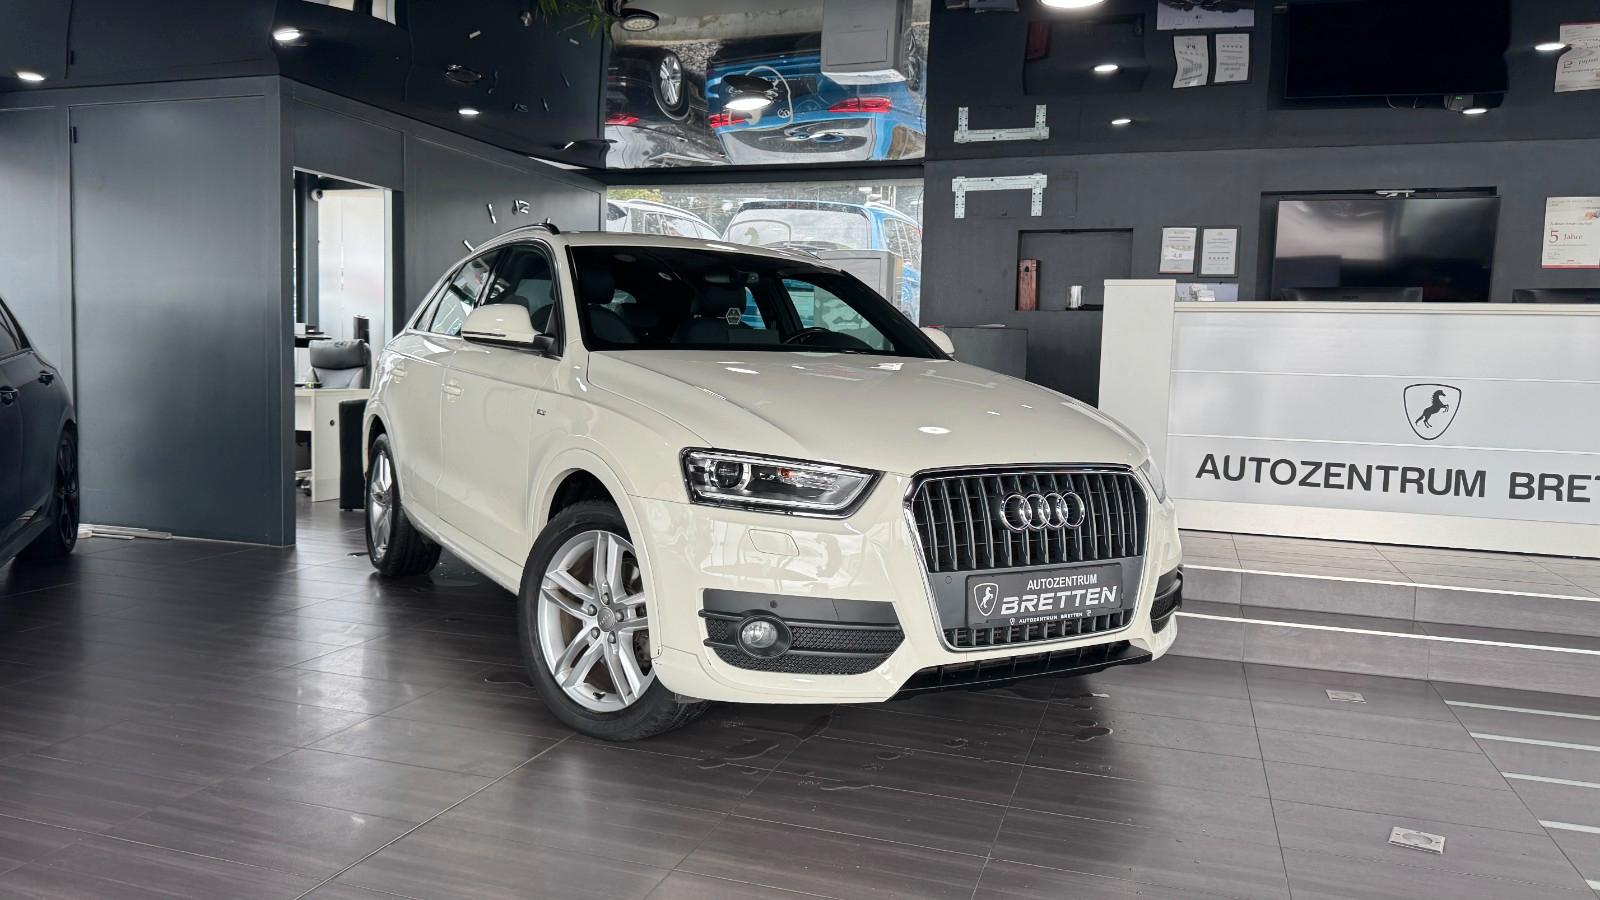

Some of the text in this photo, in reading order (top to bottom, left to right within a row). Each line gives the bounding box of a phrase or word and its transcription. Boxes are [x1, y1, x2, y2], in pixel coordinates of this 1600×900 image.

[1549, 230, 1559, 243] 5
[1196, 453, 1486, 498] AUTOZENTRUM
[1027, 573, 1097, 591] AUTOZENTRUM
[1001, 585, 1117, 615] BRETTEN
[1018, 615, 1058, 624] AUTOZENTRUM
